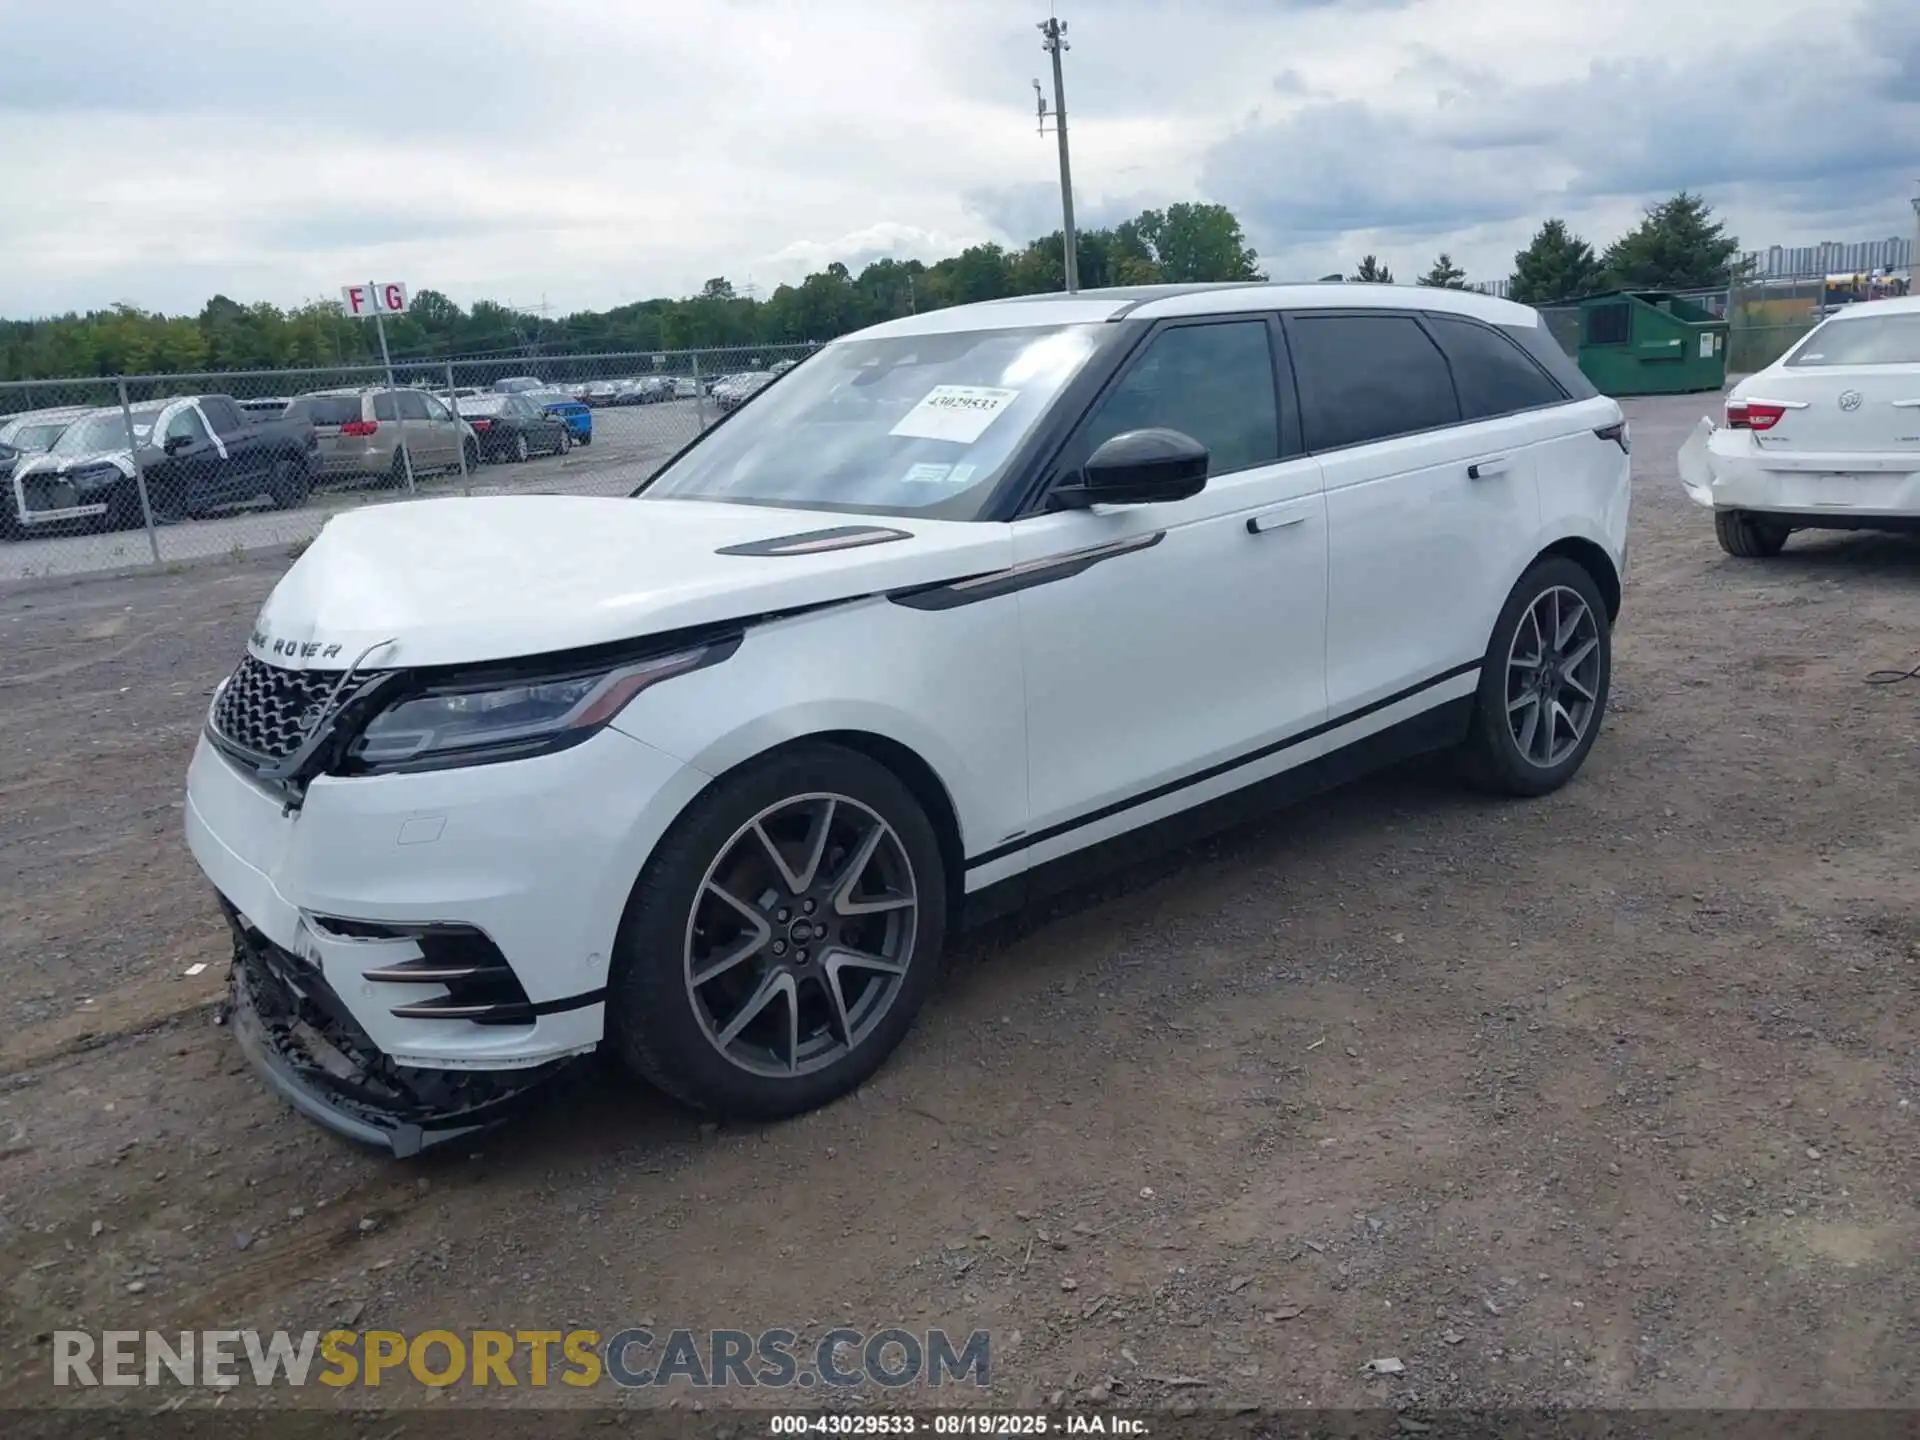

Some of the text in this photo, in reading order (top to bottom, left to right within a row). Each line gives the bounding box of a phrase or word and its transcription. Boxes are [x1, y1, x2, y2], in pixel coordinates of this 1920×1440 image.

[349, 288, 364, 313] F
[386, 285, 403, 310] G
[273, 638, 342, 658] ROVER
